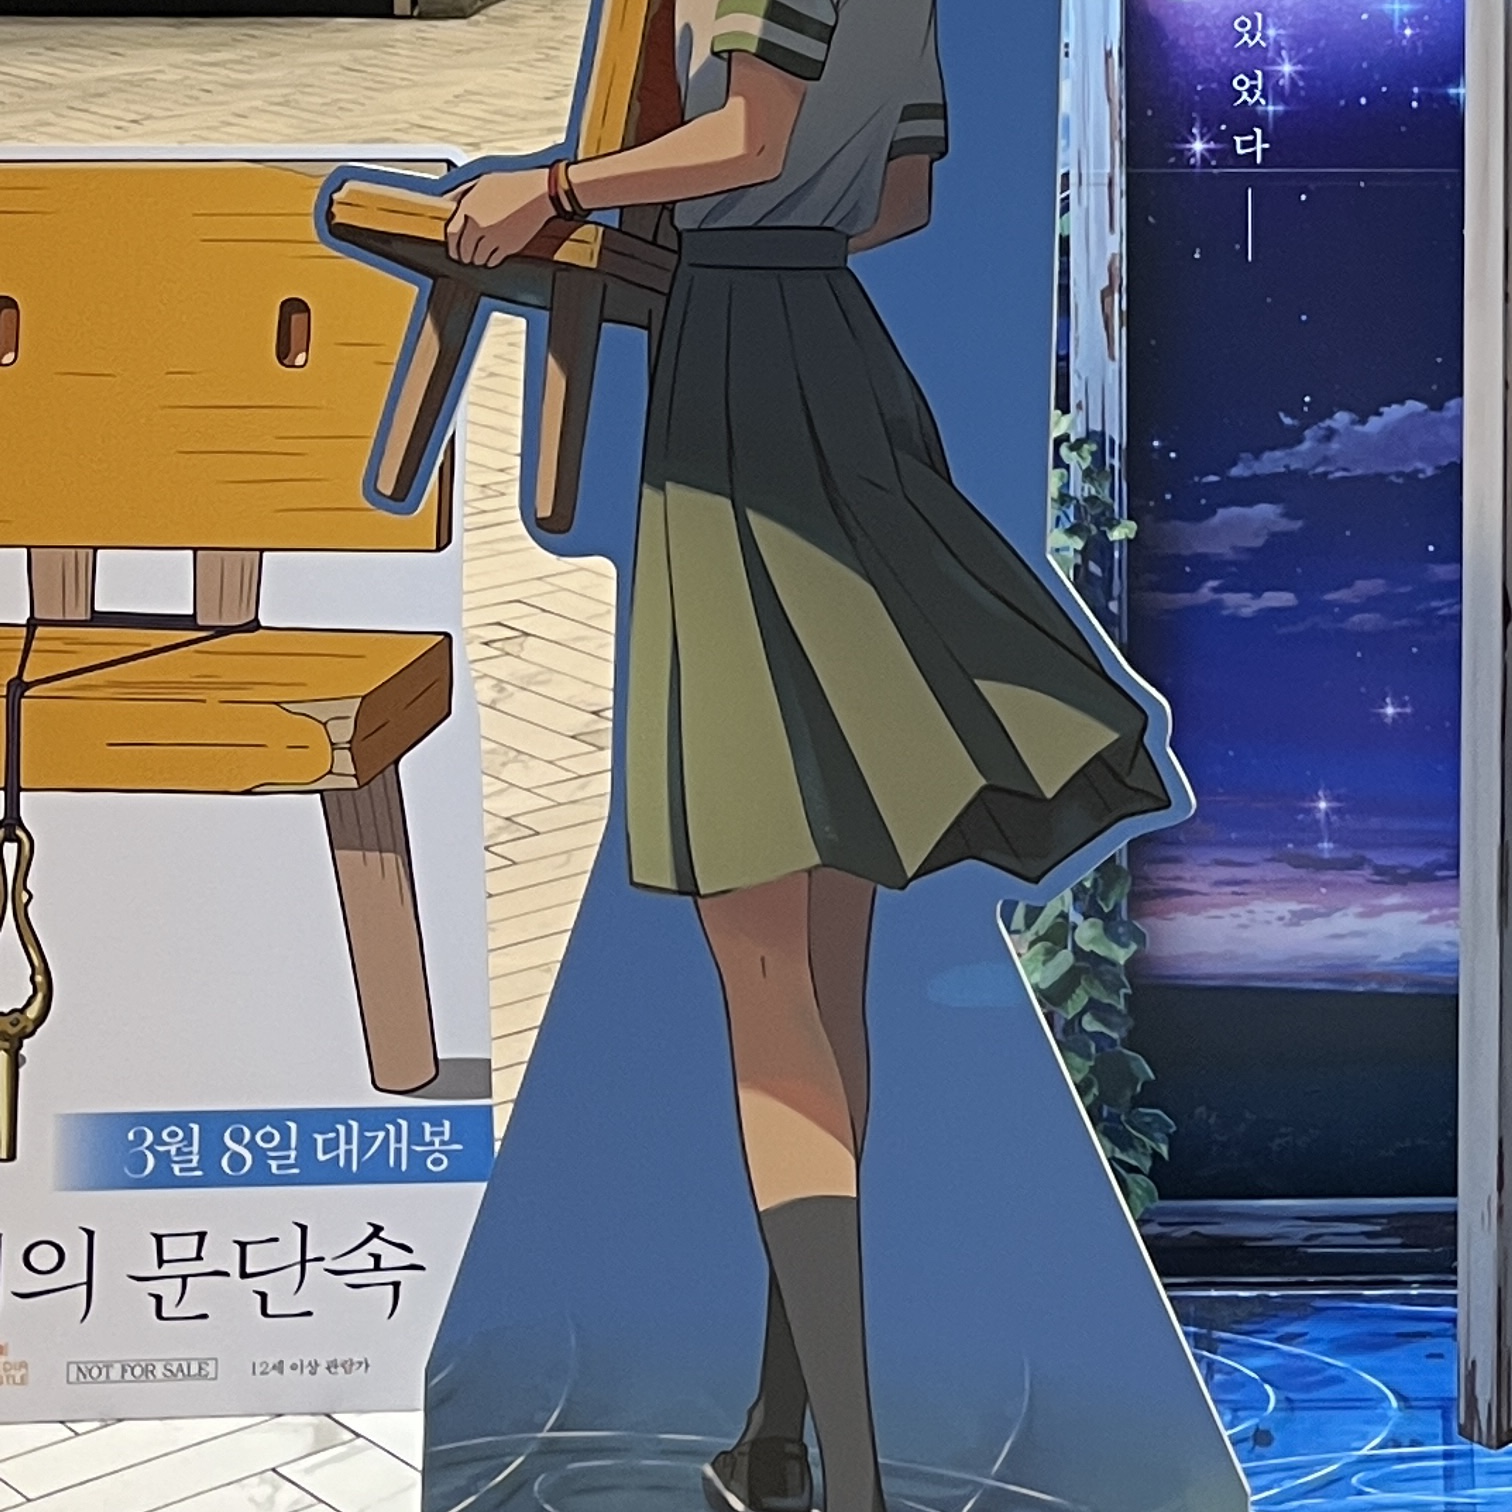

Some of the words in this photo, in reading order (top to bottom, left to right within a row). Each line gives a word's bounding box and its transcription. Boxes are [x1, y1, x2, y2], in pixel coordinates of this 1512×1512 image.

[123, 1122, 203, 1179] 3월
[220, 1121, 300, 1177] 8일
[313, 1119, 463, 1174] 대개봉
[0, 1226, 95, 1324] 의
[127, 1221, 426, 1321] 문단속
[76, 1364, 114, 1382] NOT
[121, 1363, 156, 1380] FOR
[162, 1361, 209, 1379] SALE
[251, 1361, 284, 1376] 12세
[290, 1359, 320, 1376] 이상
[325, 1357, 370, 1374] 관람가
